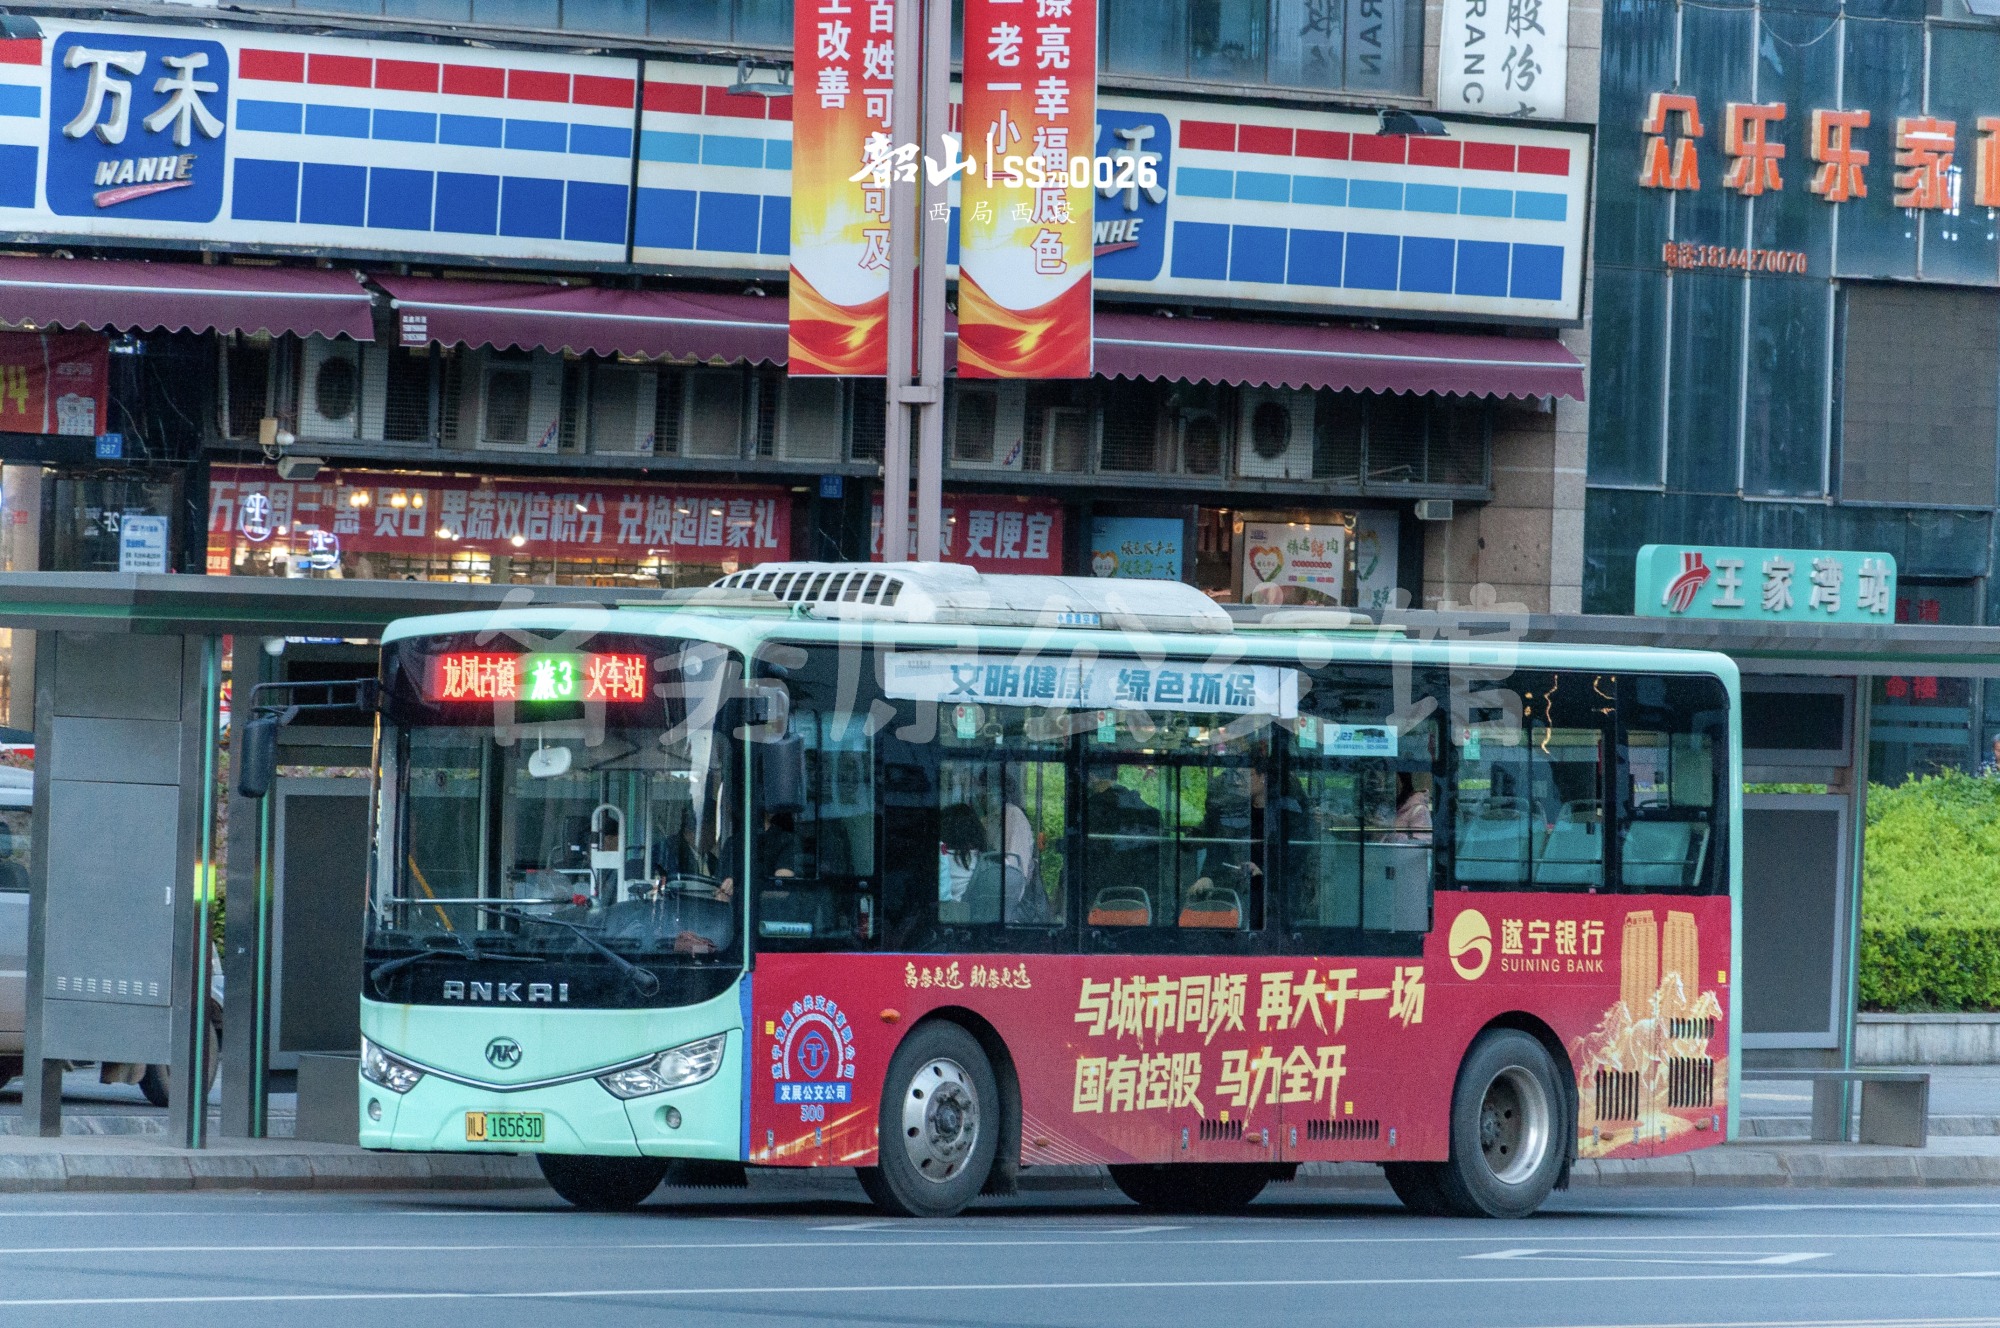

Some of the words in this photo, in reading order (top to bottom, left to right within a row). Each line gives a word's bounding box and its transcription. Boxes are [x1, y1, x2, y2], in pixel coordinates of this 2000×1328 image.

[62, 46, 225, 147] 万禾
[95, 154, 197, 186] WANHE
[1096, 124, 1167, 212] 禾
[1094, 218, 1144, 243] NHE
[617, 494, 778, 549] 兑换超值豪礼
[966, 509, 1053, 559] 更便宜
[1711, 555, 1893, 614] 王家湾站
[443, 656, 516, 698] 龙凤古镇
[587, 656, 645, 698] 火车站
[949, 663, 1095, 699] 文明健康
[1115, 668, 1256, 707] 绿色环保
[1501, 919, 1605, 955] 遂宁银行
[1501, 958, 1561, 972] SUINING
[1567, 959, 1604, 973] BANK
[443, 980, 569, 1002] ANKAI
[1074, 973, 1248, 1049] 与城市同频
[1257, 966, 1426, 1035] 再大干一场
[780, 1084, 846, 1101] 发展公交公司
[1073, 1053, 1206, 1119] 国有控股
[1216, 1045, 1347, 1130] 马力全开
[800, 1104, 825, 1122] 300
